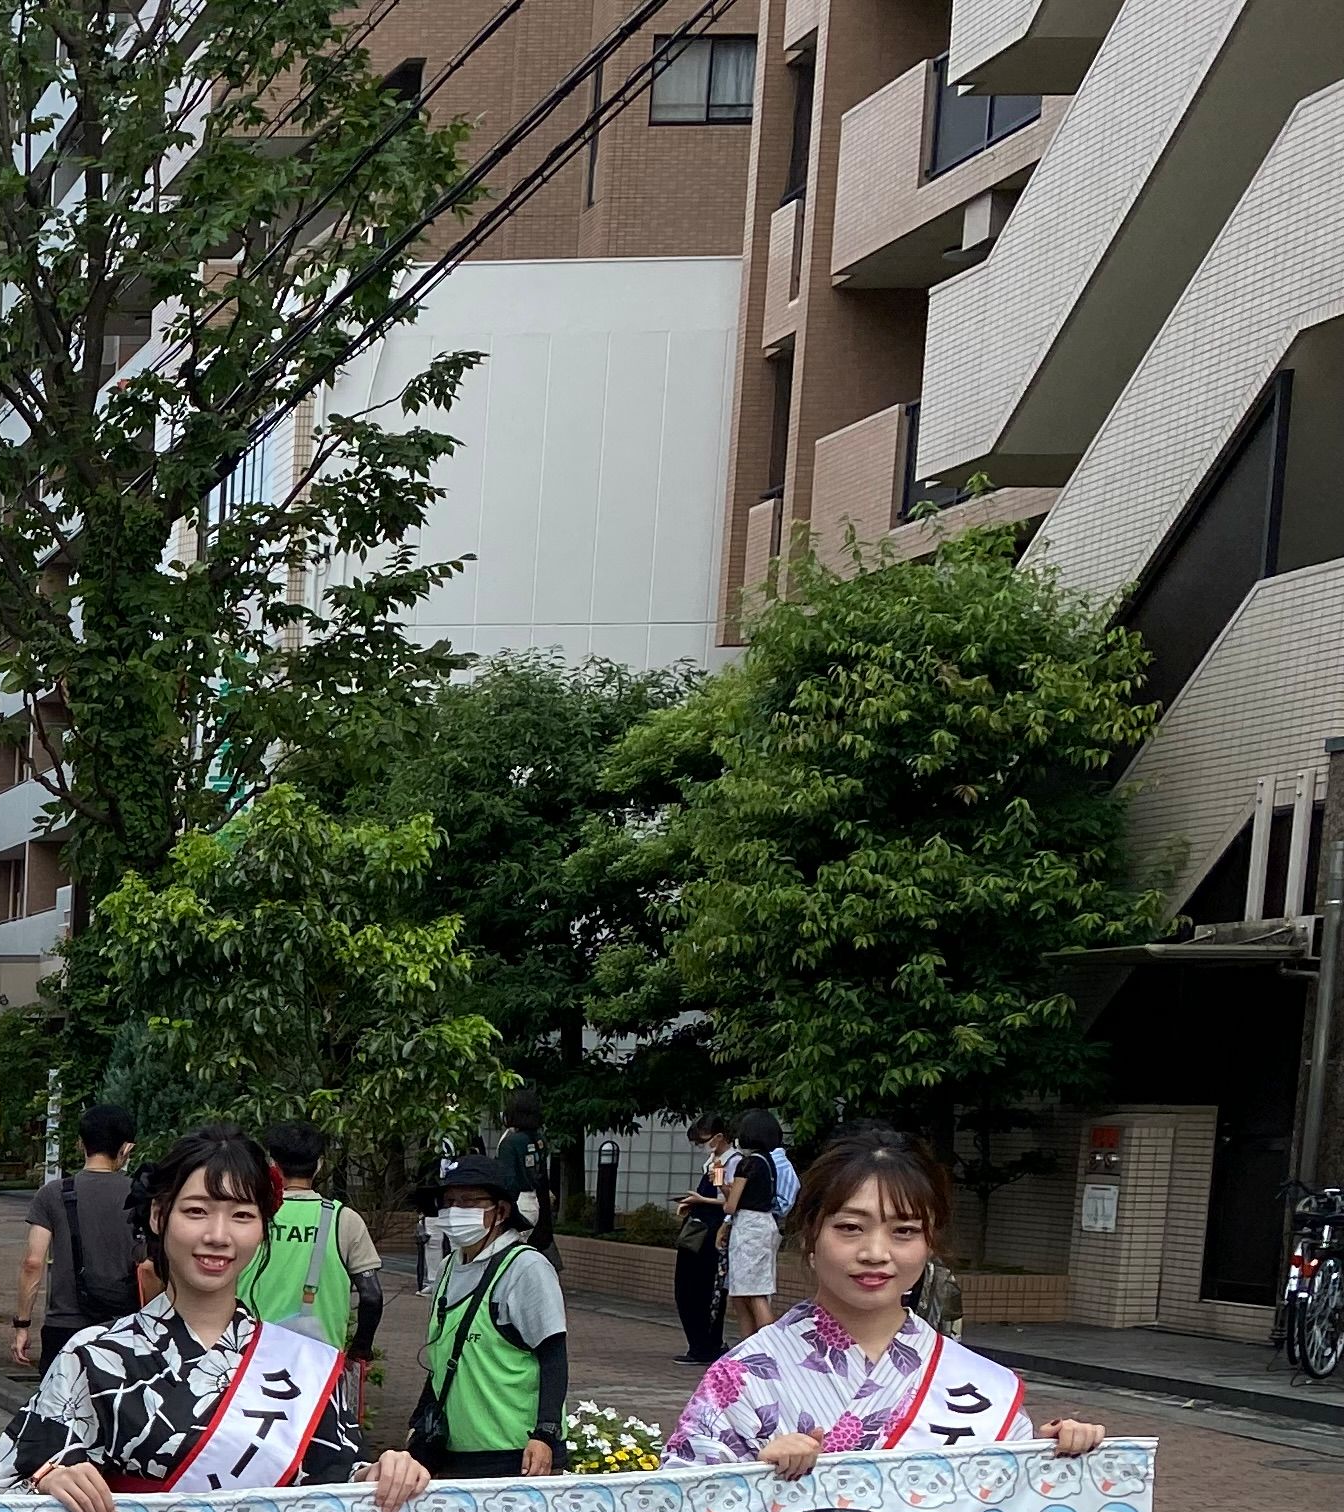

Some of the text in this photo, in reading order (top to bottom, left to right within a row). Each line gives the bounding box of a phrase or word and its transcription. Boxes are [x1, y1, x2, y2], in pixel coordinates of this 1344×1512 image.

[271, 1225, 319, 1244] TAF
[206, 1368, 302, 1491] クイー
